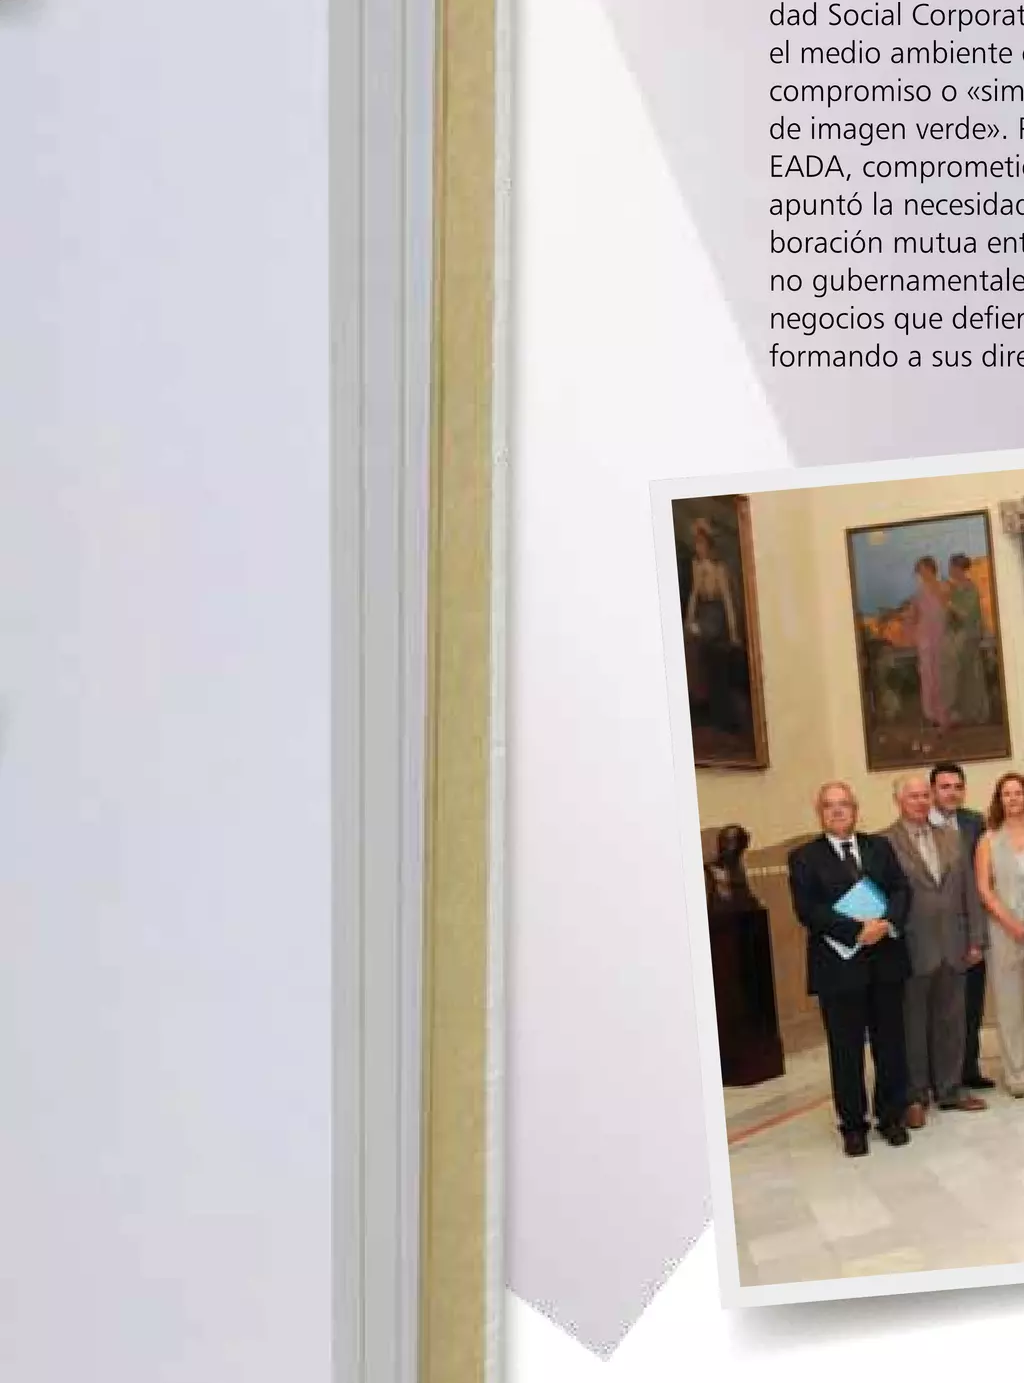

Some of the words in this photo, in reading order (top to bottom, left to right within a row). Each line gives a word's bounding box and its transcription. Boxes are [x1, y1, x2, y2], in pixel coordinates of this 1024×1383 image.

[769, 39, 790, 65] el
[801, 39, 881, 65] medio
[890, 39, 1013, 65] ambiente
[770, 154, 852, 182] EADA,
[770, 305, 885, 336] negocios
[894, 312, 943, 336] que
